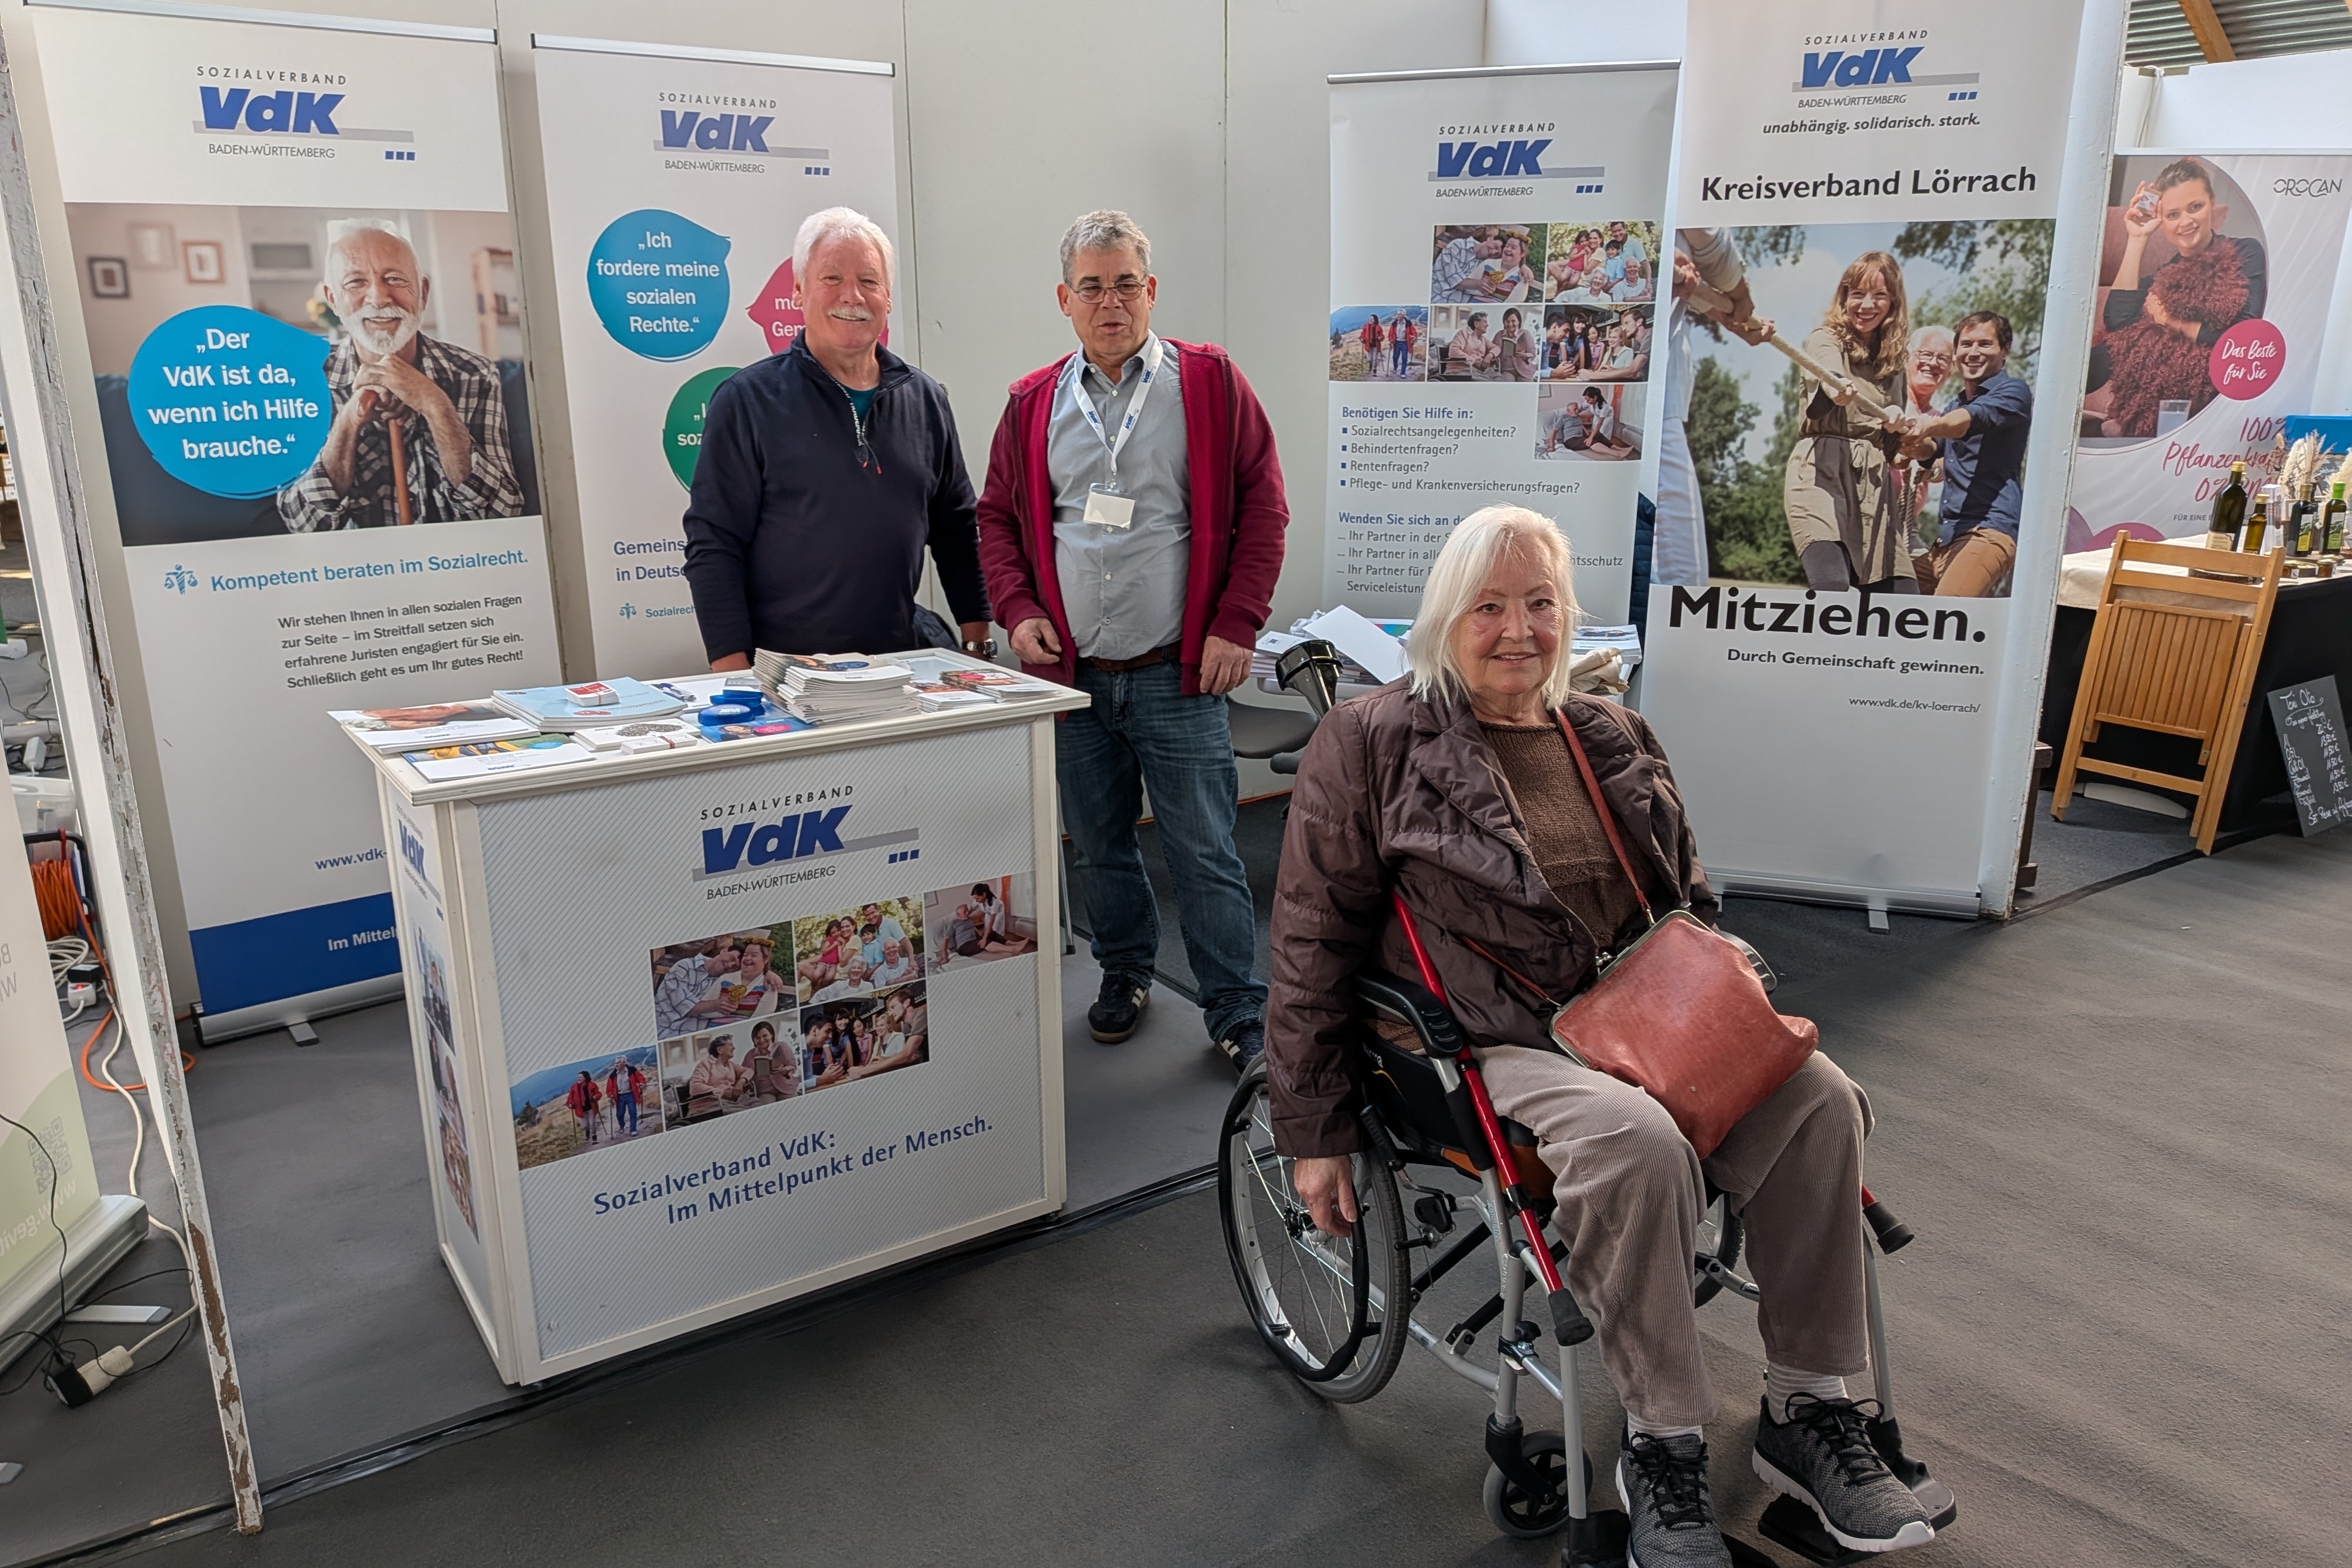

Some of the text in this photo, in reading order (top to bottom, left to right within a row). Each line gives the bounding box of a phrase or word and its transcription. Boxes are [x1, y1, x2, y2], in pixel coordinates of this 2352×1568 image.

[1805, 31, 1927, 45] SOZIALVERBAND
[198, 66, 346, 85] SOZIALVERBAND
[1801, 46, 1925, 88] VdK
[659, 92, 776, 108] SOZIALVERBAND
[1798, 95, 1907, 108] BADEN-WÜRTTEMBERG
[200, 86, 346, 135] VdK
[660, 109, 775, 152] VdK
[1439, 123, 1555, 135] SOZIALVERBAND
[1763, 113, 1980, 135] unabhängig. solidarisch. stark.
[209, 144, 335, 158] BADEN-WÜRTTEMBERG
[1437, 139, 1552, 178] VdK
[665, 160, 764, 173] BADEN-WÜRTTEMBERG
[1436, 186, 1533, 197] BADEN-WÜRTTEMBERG
[1702, 166, 2035, 200] Kreisverband Lörrach
[639, 232, 671, 250] „Ich
[596, 259, 719, 276] fordere meine
[627, 289, 696, 304] sozialen
[630, 316, 699, 332] Rechte.“
[197, 329, 249, 353] „Der
[2221, 339, 2245, 359] Das
[163, 364, 295, 386] VdK ist da,
[2223, 362, 2266, 385] für Sie
[148, 398, 318, 424] wenn ich Hilfe
[1343, 407, 1473, 421] Benötigen Sie Hilfe in:
[677, 433, 703, 445] soz
[1352, 425, 1516, 439] Sozialrechtsangelegenheiten?
[183, 434, 295, 459] brauche.“
[1352, 443, 1458, 457] Behindertenfragen?
[1351, 460, 1429, 474] Rentenfragen?
[1351, 478, 1579, 495] Pflege- und Krankenversicherungsfragen?
[1339, 512, 1382, 524] Wenden
[1387, 514, 1404, 524] Sie
[1408, 514, 1430, 525] sich
[1349, 530, 1364, 540] Ihr
[1368, 531, 1406, 541] Partner
[1410, 533, 1419, 542] in
[1424, 533, 1441, 542] der
[614, 539, 689, 555] Gemeins
[1349, 547, 1363, 557] Ihr
[1367, 548, 1405, 559] Partner
[1409, 550, 1419, 559] in
[1571, 556, 1623, 566] tsschutz
[212, 550, 527, 591] Kompetent beraten im Sozialrecht.
[616, 564, 686, 581] in Deutsc
[1348, 564, 1362, 574] Ihr
[1367, 565, 1405, 576] Partner
[1408, 566, 1424, 576] für
[1347, 581, 1425, 593] Serviceleistun
[278, 597, 522, 628] Wir stehen Ihnen in allen sozialen Fragen
[1669, 585, 1986, 643] Mitziehen.
[282, 639, 301, 648] zur
[305, 631, 338, 646] Seite
[354, 631, 370, 641] im
[374, 623, 425, 638] Streitfall
[428, 621, 467, 632] setzen
[470, 617, 494, 628] sich
[285, 633, 523, 668] erfahrene Juristen engagiert für Sie ein.
[288, 650, 523, 688] Schließlich geht es um Ihr gutes Recht!
[1728, 649, 1983, 674] Durch Gemeinschaft gewinnen.
[1849, 698, 1980, 713] www.vdk.de/kv-loerrach/
[701, 786, 853, 821] SOZIALVERBAND
[702, 805, 854, 875] VdK
[398, 818, 426, 882] VdK
[704, 865, 836, 900] BADEN-WÜRTTEMBERG
[328, 927, 398, 951] Im Mittel
[594, 1131, 834, 1216] Sozialverband VdK:
[669, 1116, 992, 1224] Im Mittelpunkt der Mensch.
